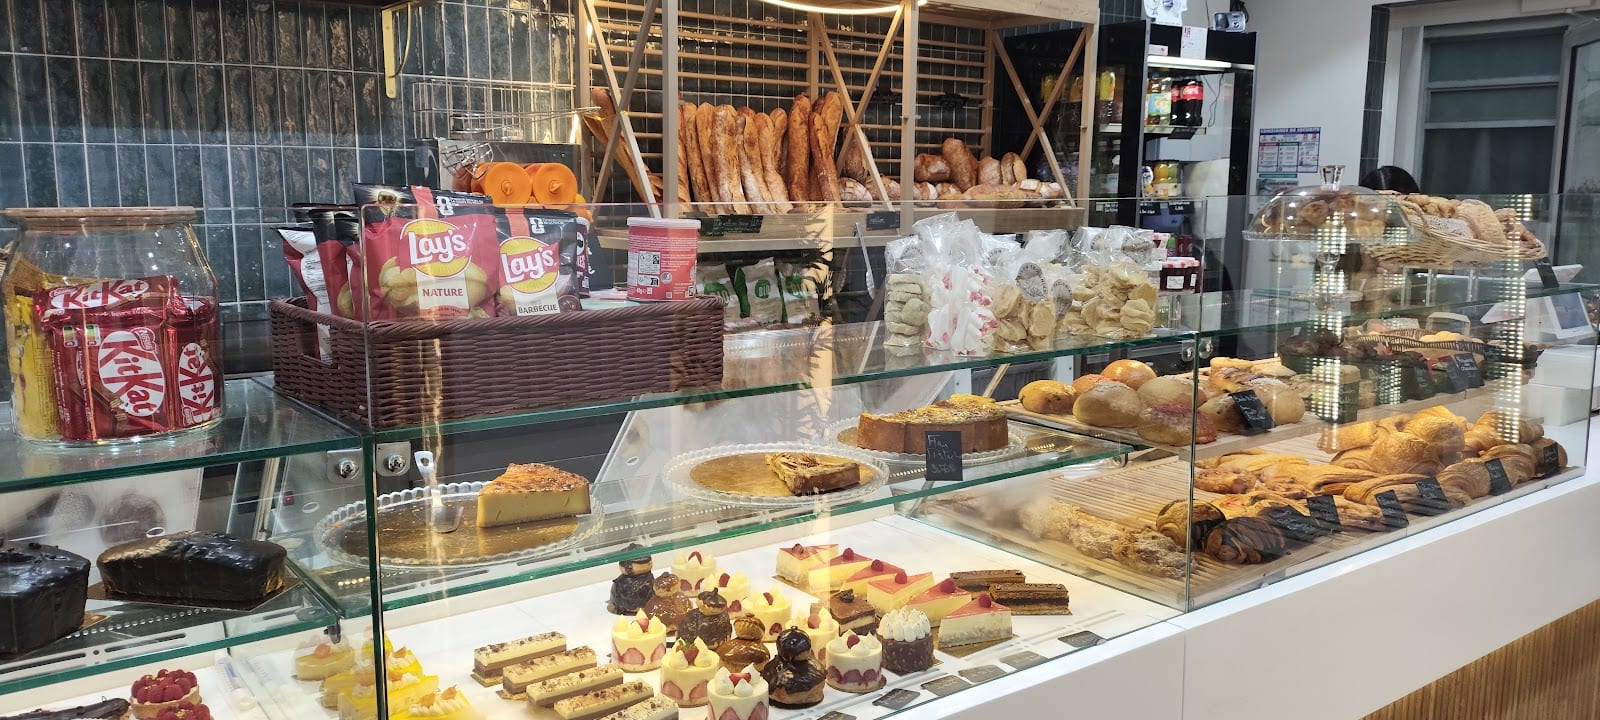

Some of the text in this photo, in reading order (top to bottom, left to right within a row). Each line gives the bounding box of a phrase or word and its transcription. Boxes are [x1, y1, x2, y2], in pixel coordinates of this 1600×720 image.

[407, 230, 467, 265] Lay's
[501, 247, 554, 284] Lay's
[61, 279, 146, 309] KitKat
[422, 287, 464, 297] NATURE
[518, 303, 558, 314] BARBECUE
[99, 340, 165, 414] KitKat
[179, 346, 214, 415] KitKat
